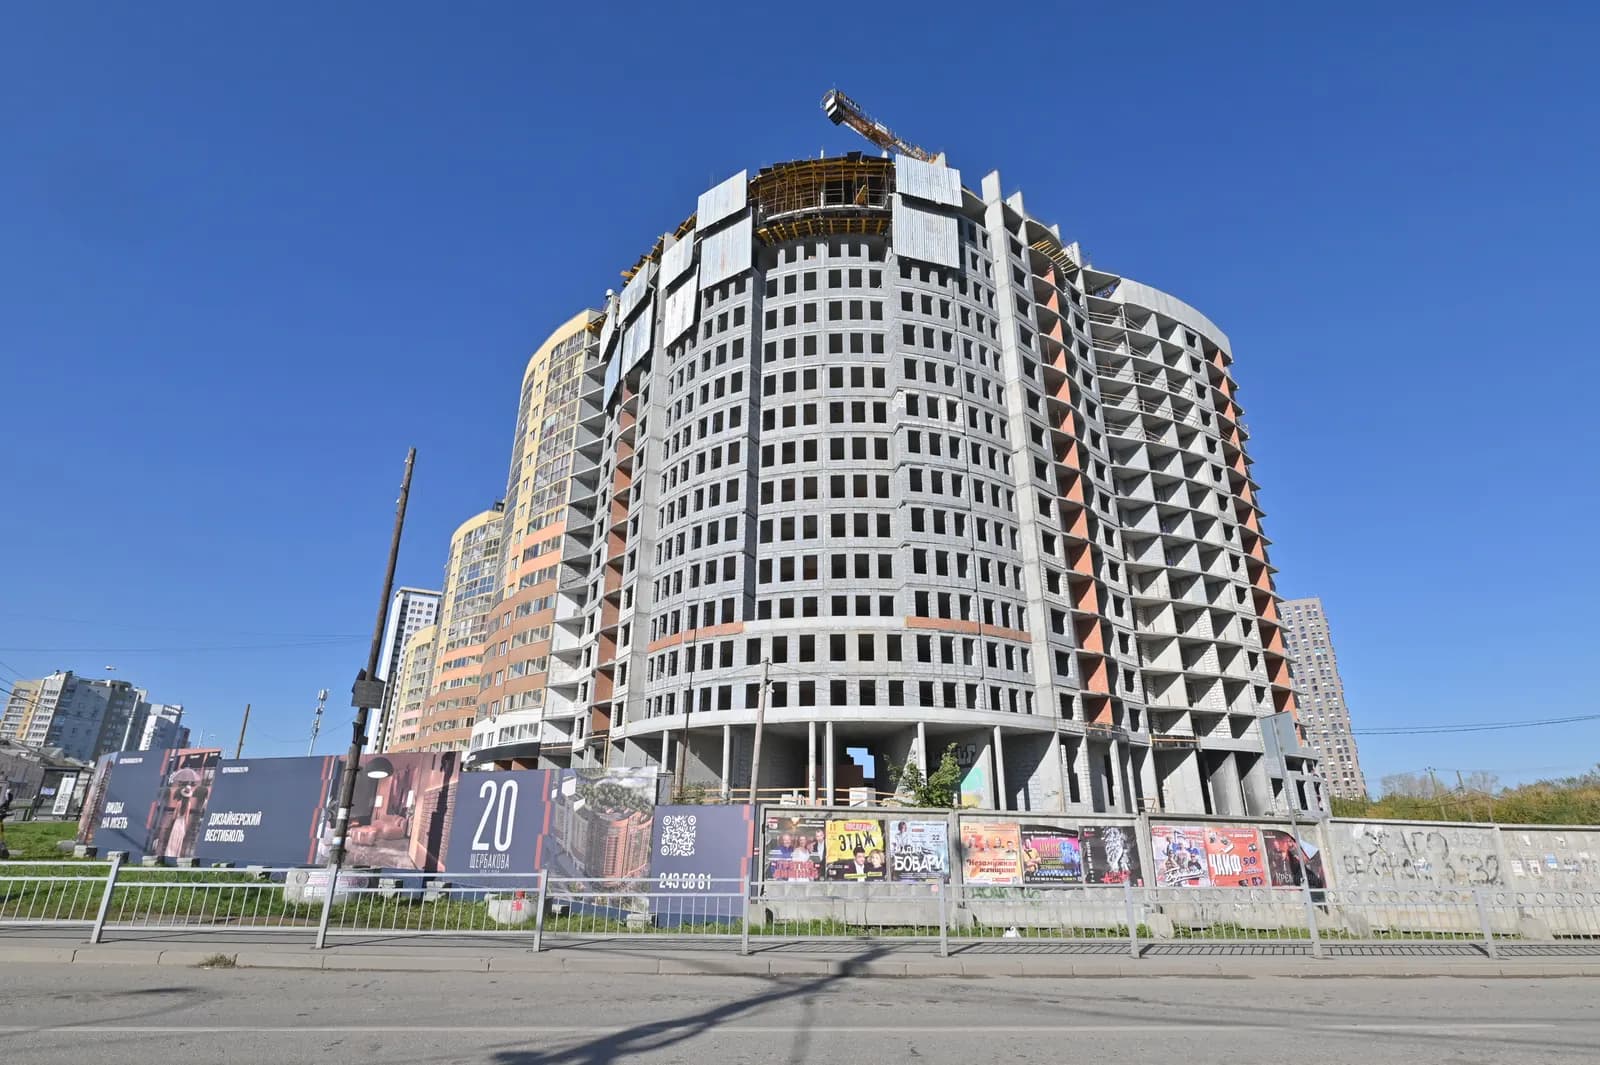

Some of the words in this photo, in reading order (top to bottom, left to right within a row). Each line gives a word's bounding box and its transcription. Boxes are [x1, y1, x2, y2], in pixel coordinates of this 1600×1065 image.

[105, 801, 124, 815] ВИДЫ
[471, 778, 519, 852] 20
[100, 816, 110, 829] НА
[110, 816, 128, 830] ИСЕТЬ
[208, 810, 262, 827] ДИЗАЙНЕРСКИЙ
[204, 828, 245, 842] ВЕСТИБЮЛЬ
[838, 830, 876, 852] ЭТАЖ
[894, 855, 945, 873] БОВАРИ
[659, 872, 680, 889] 243
[697, 873, 711, 890] 81
